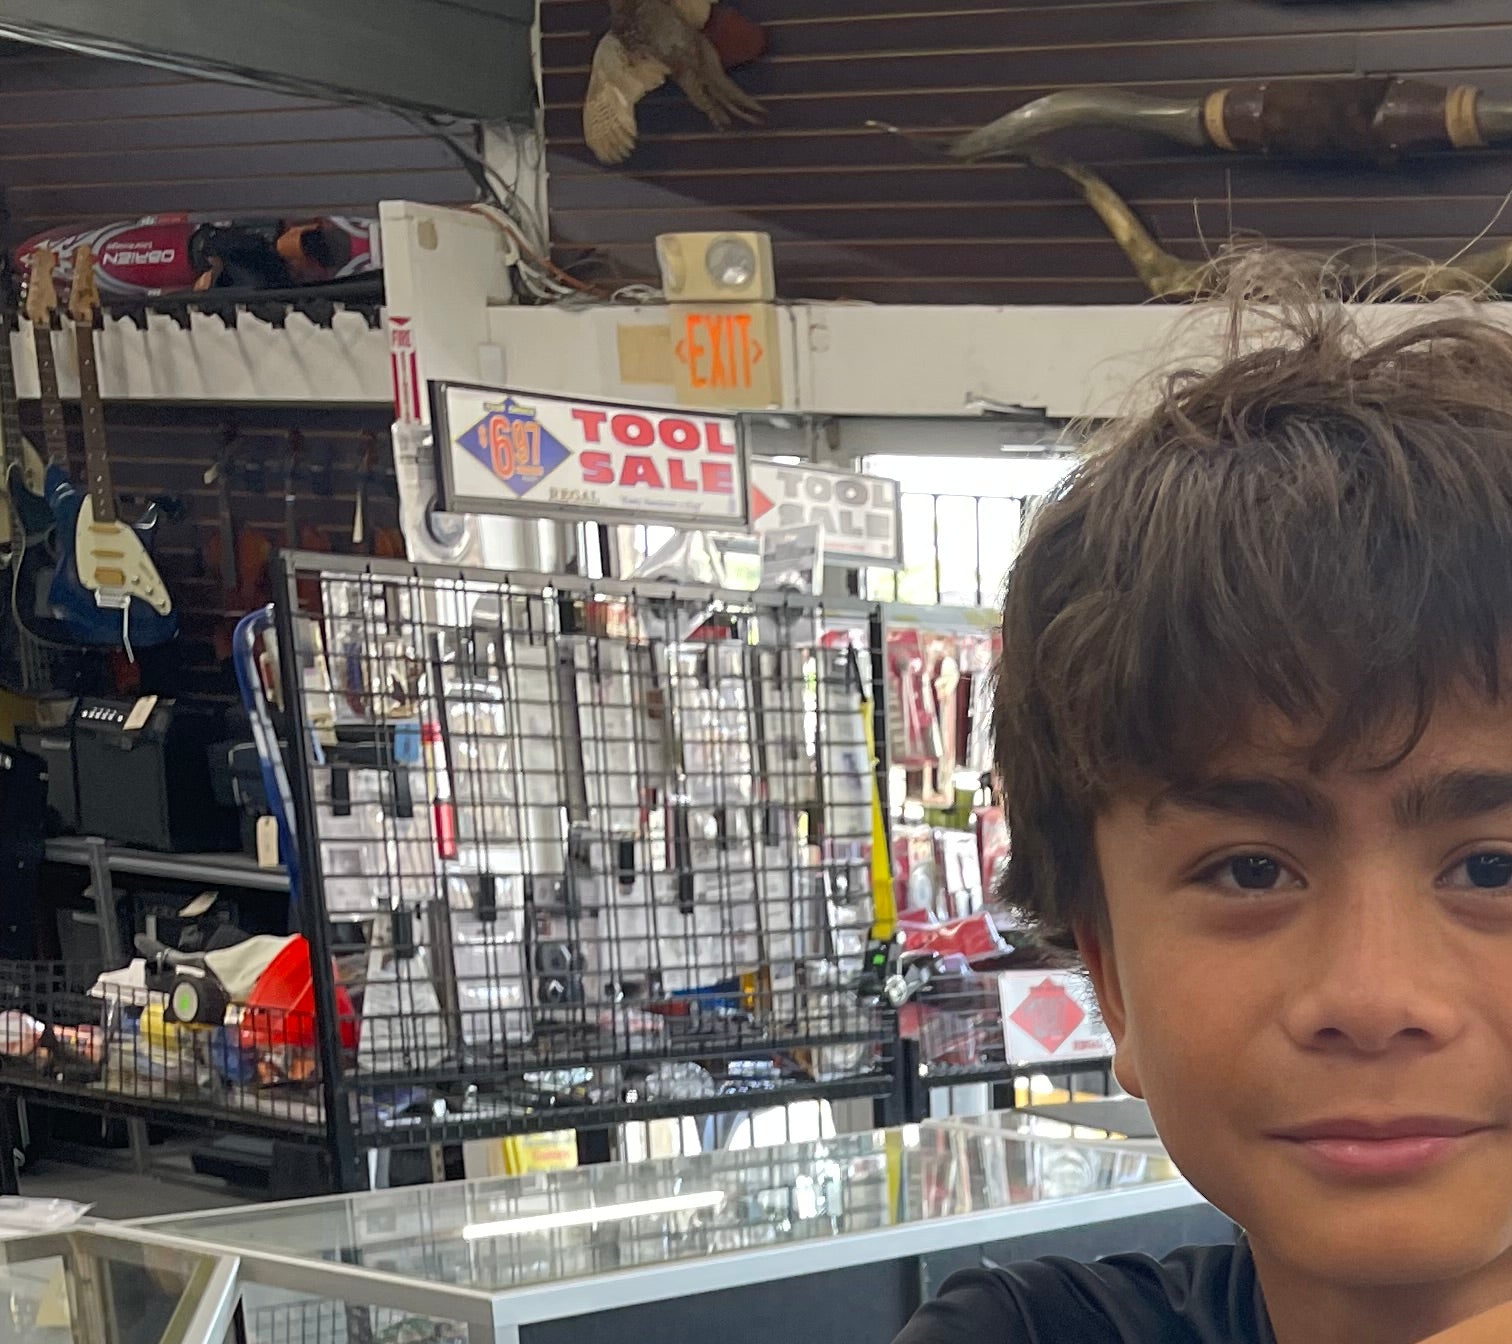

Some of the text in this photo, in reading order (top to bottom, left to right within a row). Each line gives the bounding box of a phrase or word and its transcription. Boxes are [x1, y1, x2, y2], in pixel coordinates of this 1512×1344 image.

[686, 314, 752, 389] EXIT
[570, 407, 736, 455] TOOL
[579, 450, 734, 495] SALE
[776, 470, 893, 508] TOOL
